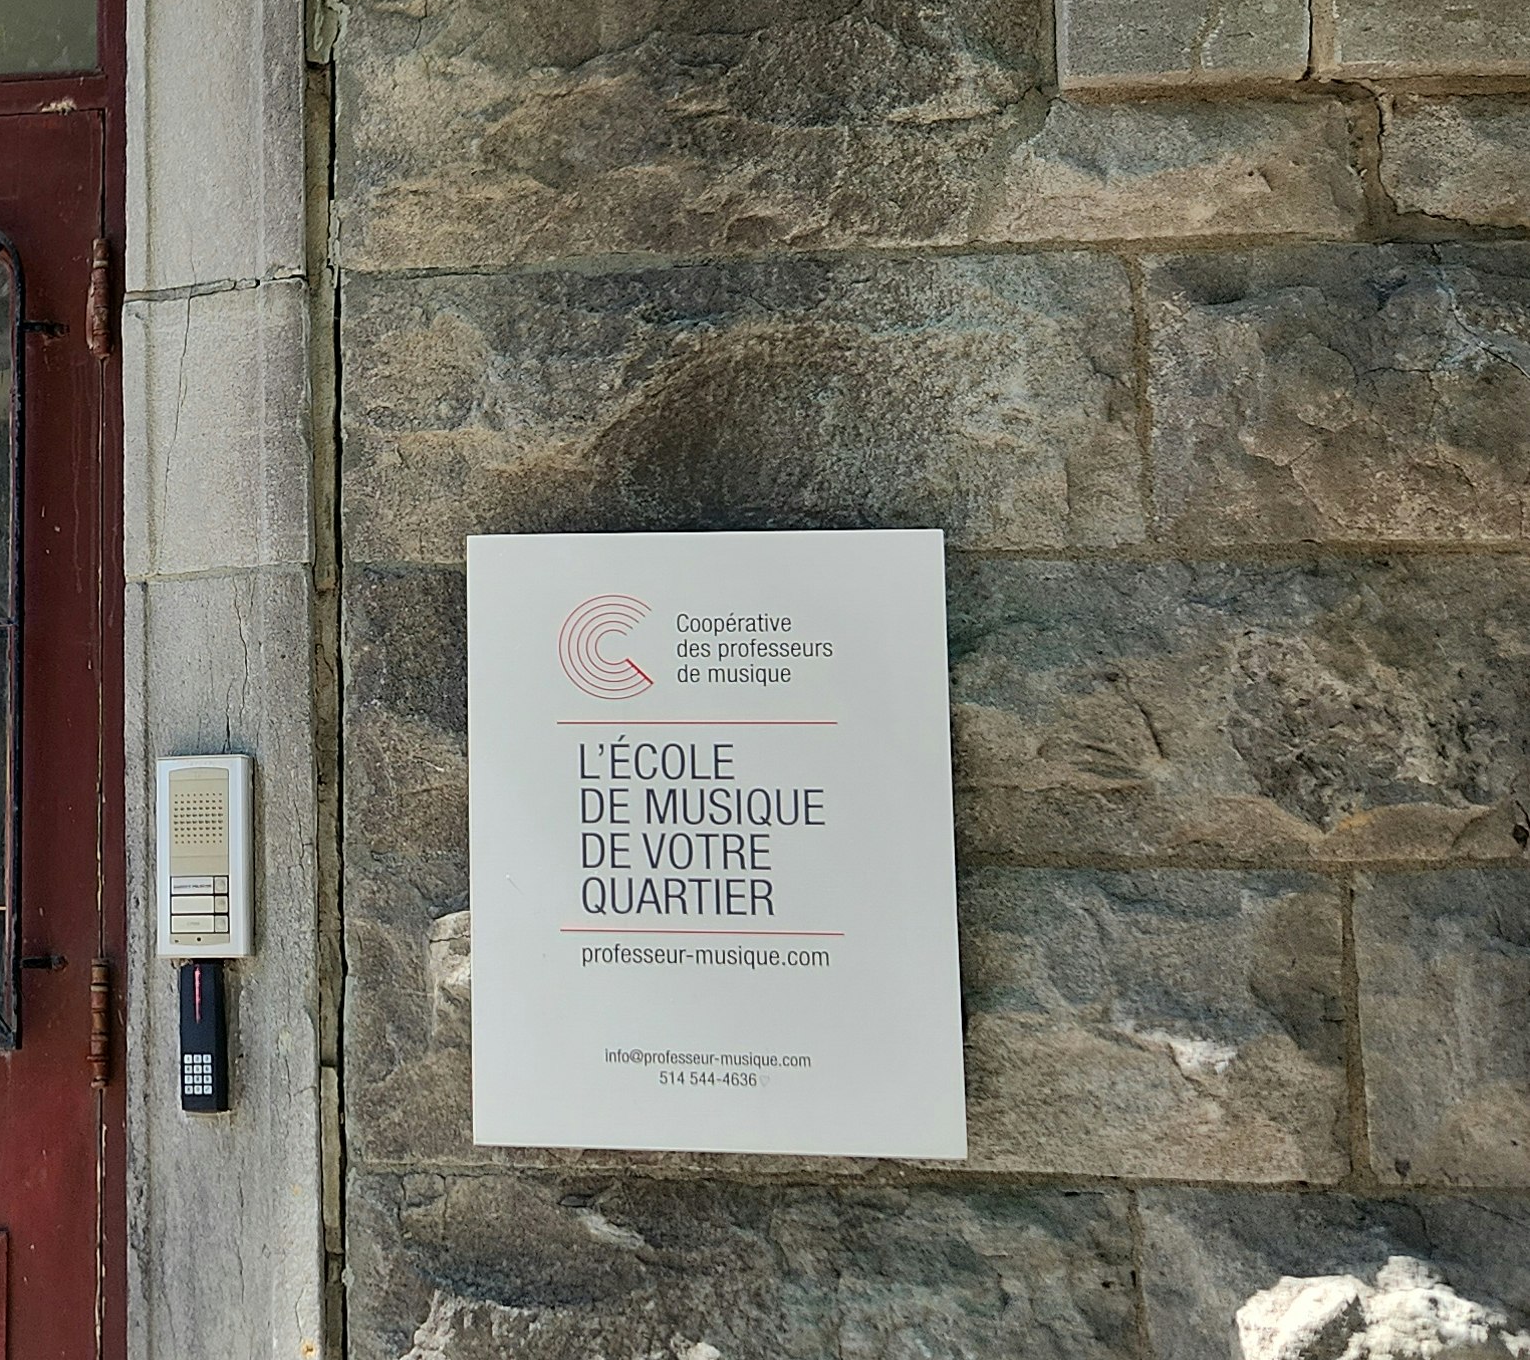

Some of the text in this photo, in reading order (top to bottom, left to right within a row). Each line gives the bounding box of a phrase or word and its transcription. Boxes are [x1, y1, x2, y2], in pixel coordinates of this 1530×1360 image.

[676, 612, 792, 636] Coopérative
[677, 639, 833, 661] des professeurs
[677, 664, 791, 686] de musique
[579, 734, 735, 780] L'ÉCOLE
[581, 788, 825, 827] DE MUSIQUE
[581, 832, 771, 870] DE VOTRE
[582, 876, 774, 916] QUARTIER
[581, 943, 830, 969] professeur-musique.com
[605, 1048, 811, 1069] info@professeur-musique.com
[659, 1071, 757, 1087] 514 544-4636
